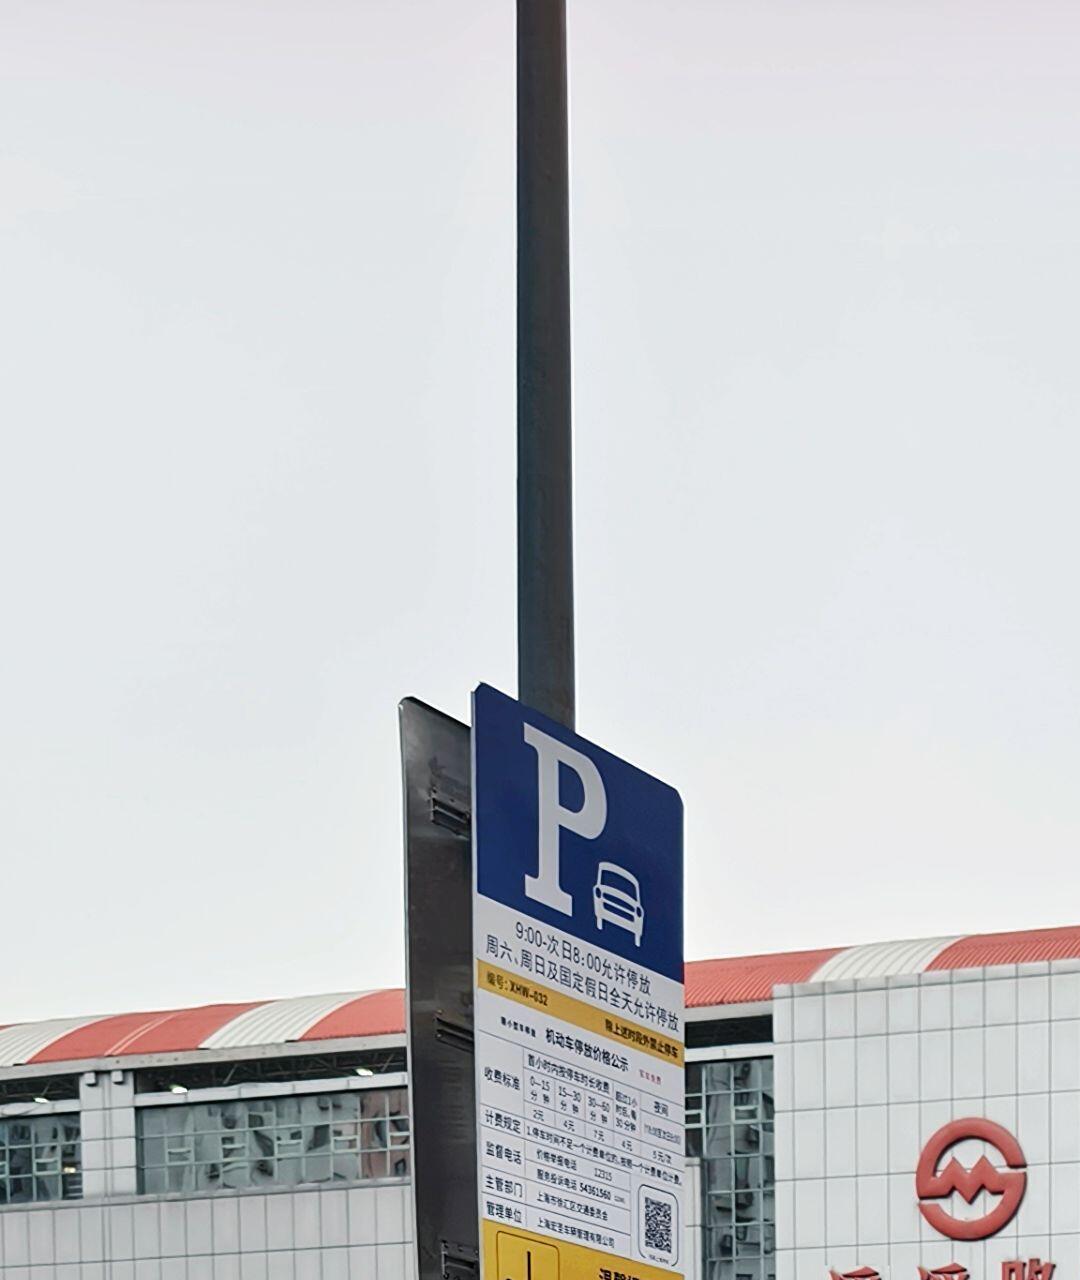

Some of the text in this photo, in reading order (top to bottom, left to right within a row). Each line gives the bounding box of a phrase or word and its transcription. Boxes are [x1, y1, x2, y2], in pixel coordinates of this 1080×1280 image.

[523, 722, 608, 917] P
[515, 921, 651, 996] 9:00-次日8:00允许停放
[486, 934, 680, 1032] 周六、周日及国定假日全天允许停放
[545, 1027, 629, 1072] 机动车停放价格公示
[484, 1066, 520, 1091] 收费标准
[484, 1109, 522, 1134] 计费规定
[486, 1174, 523, 1198] 主管部门
[486, 1201, 522, 1223] 管理单位
